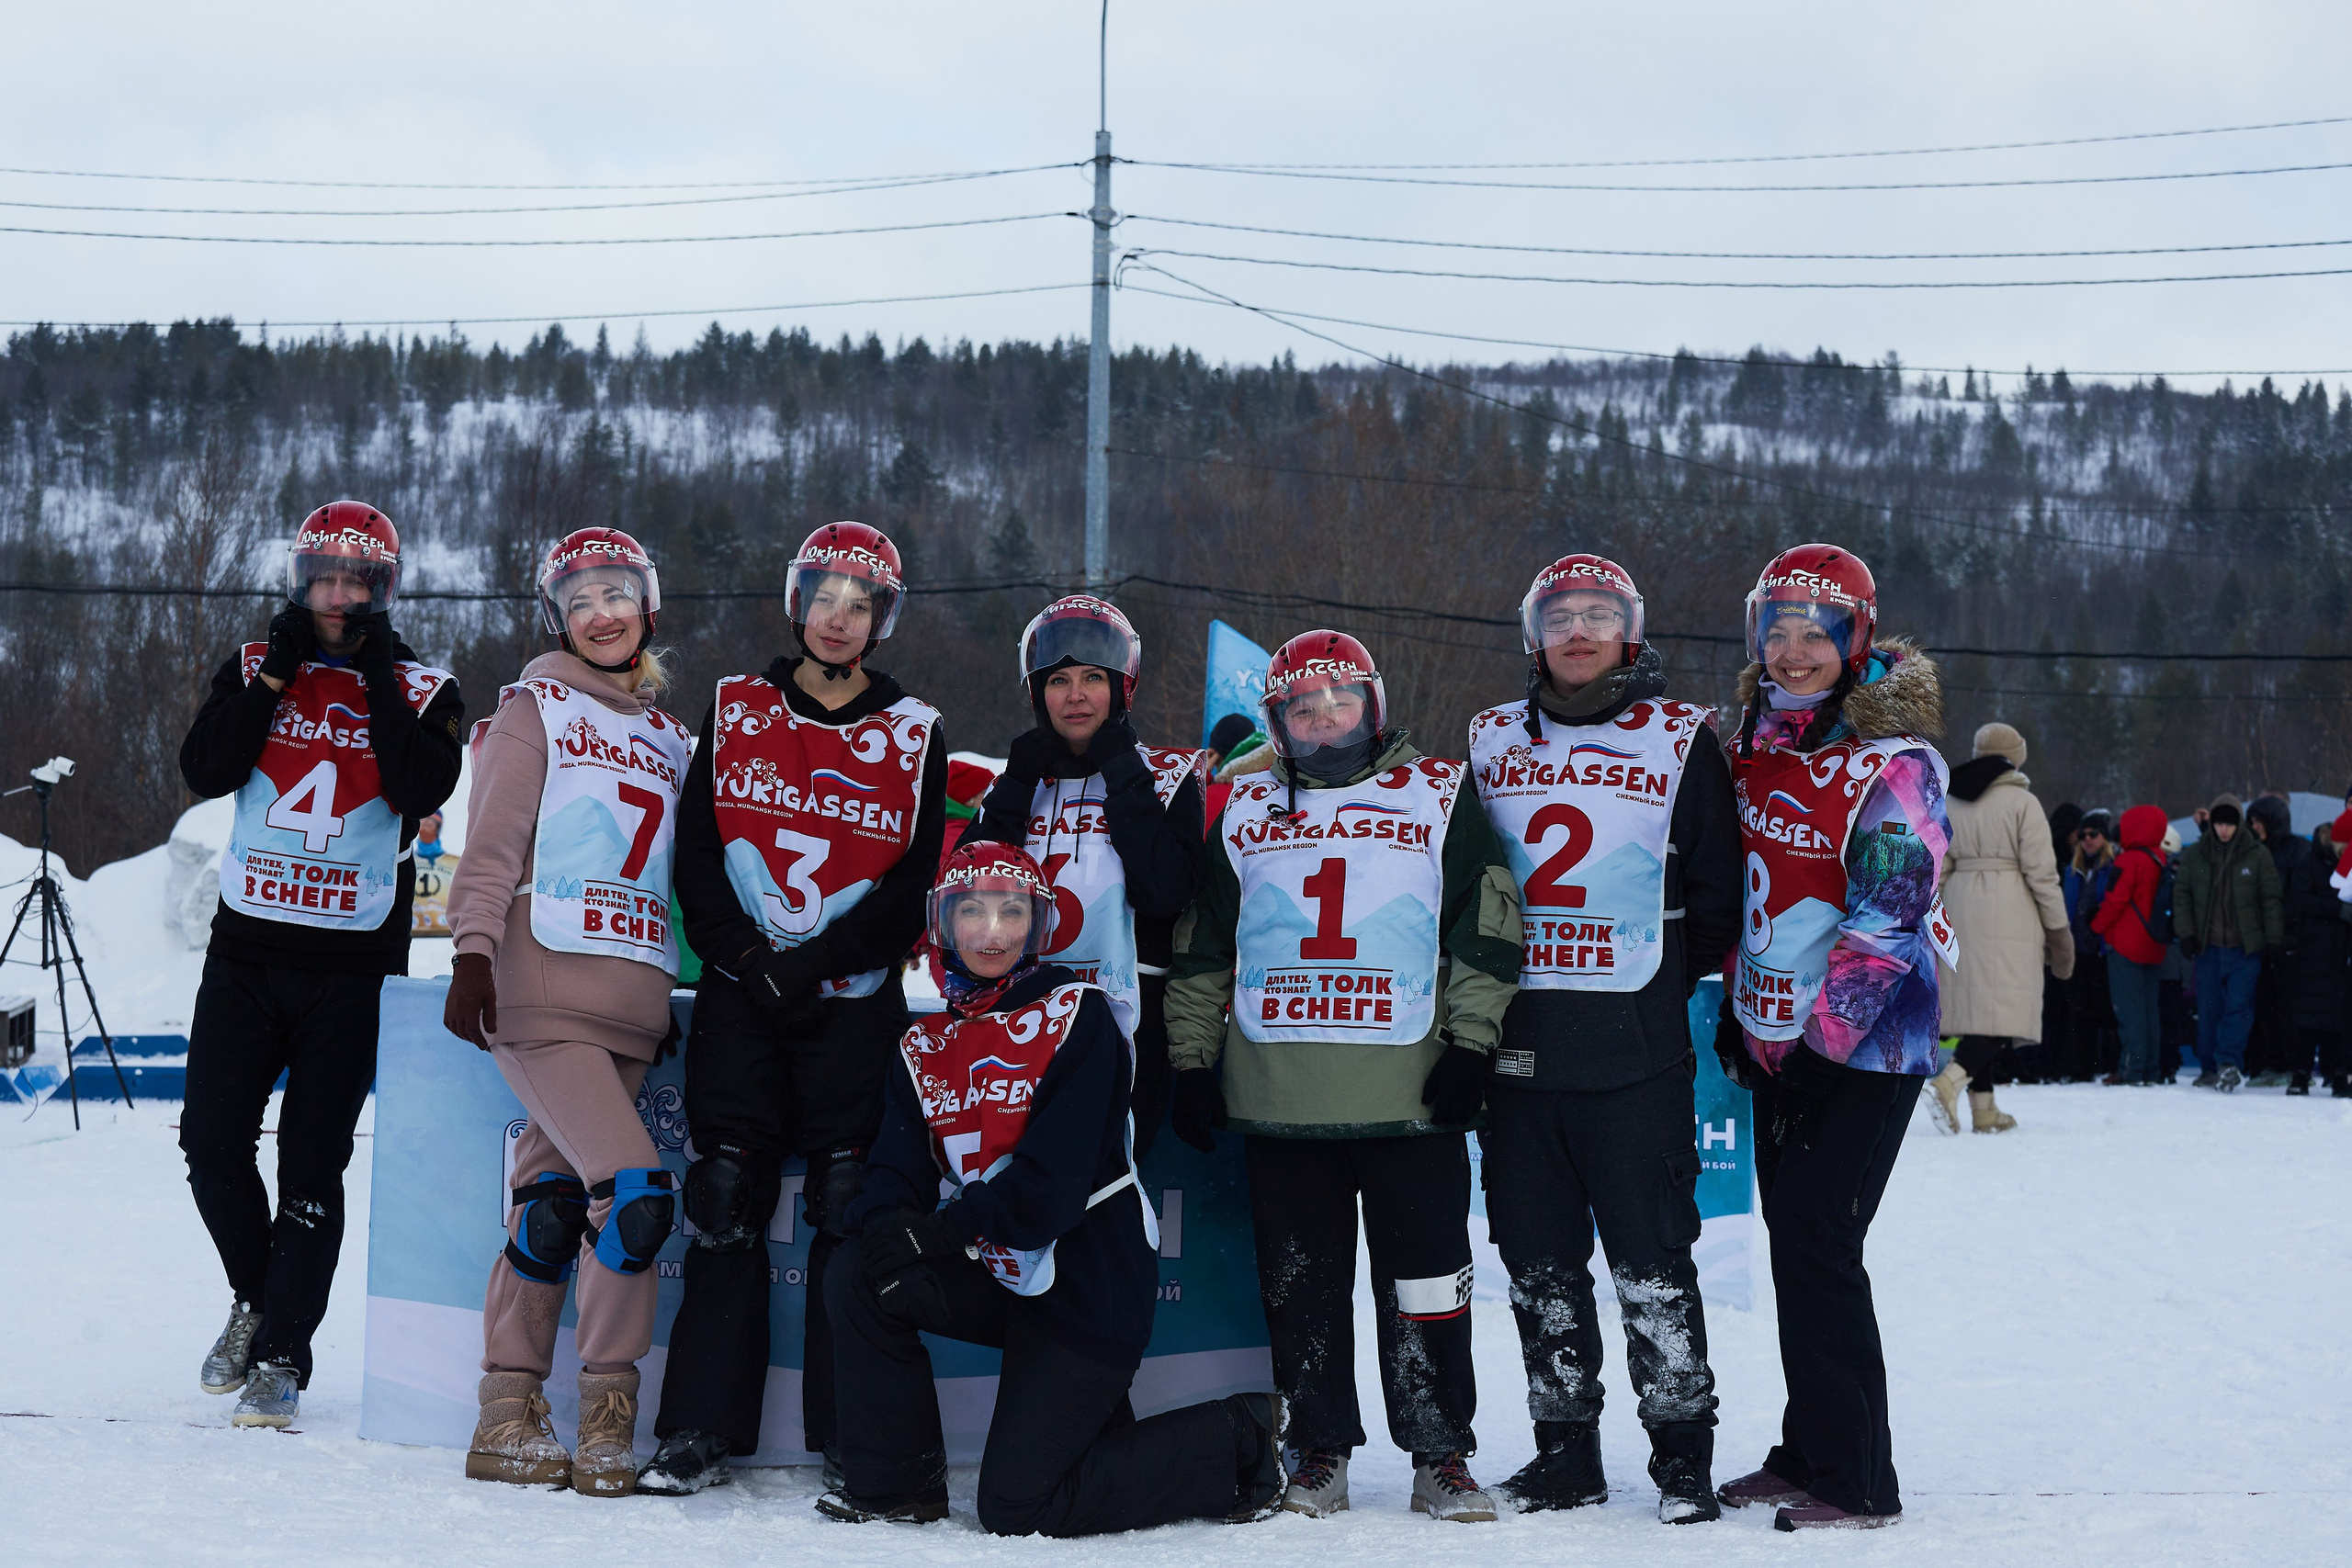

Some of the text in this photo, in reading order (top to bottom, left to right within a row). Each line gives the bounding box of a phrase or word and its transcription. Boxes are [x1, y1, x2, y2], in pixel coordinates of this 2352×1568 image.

[1496, 791, 1525, 799] MURMANSK
[1615, 793, 1665, 807] СНЕЖНЫЙ БОЙ
[266, 760, 344, 853] 4
[737, 803, 772, 815] MURMANSK
[617, 781, 665, 881] 7
[853, 829, 900, 843] СНЕЖНЫЙ БОЙ
[1259, 844, 1291, 853] MURMANSK
[1388, 843, 1423, 853] СНЕЖНЫЙ
[1523, 803, 1593, 908] 2
[1786, 850, 1820, 859] СНЕЖНЫЙ
[245, 865, 284, 878] КТО ЗНАЕТ
[247, 855, 285, 870] ДЛЯ ТЕХ,
[291, 863, 359, 886] ТОЛК
[763, 828, 831, 935] 3
[244, 875, 357, 911] В СНЕГЕ
[584, 887, 630, 902] ДЛЯ ТЕХ,
[584, 898, 630, 911] КТО ЗНАЕТ
[1300, 857, 1357, 959] 1
[1746, 851, 1773, 956] 8
[583, 908, 604, 931] В
[1542, 921, 1613, 942] ТОЛК
[1932, 921, 1949, 945] В
[764, 974, 781, 997] SPORT
[1266, 975, 1311, 986] ДЛЯ ТЕХ,
[1317, 975, 1392, 995] ТОЛК
[1747, 966, 1794, 995] ТОЛК
[1264, 986, 1311, 994] КТО ЗНАЕТ
[1261, 997, 1392, 1021] В СНЕГЕ
[935, 1117, 956, 1127] REGION
[1712, 1158, 1736, 1170] БОЙ
[905, 1227, 922, 1255] SPORT
[879, 1280, 899, 1296] SPORT
